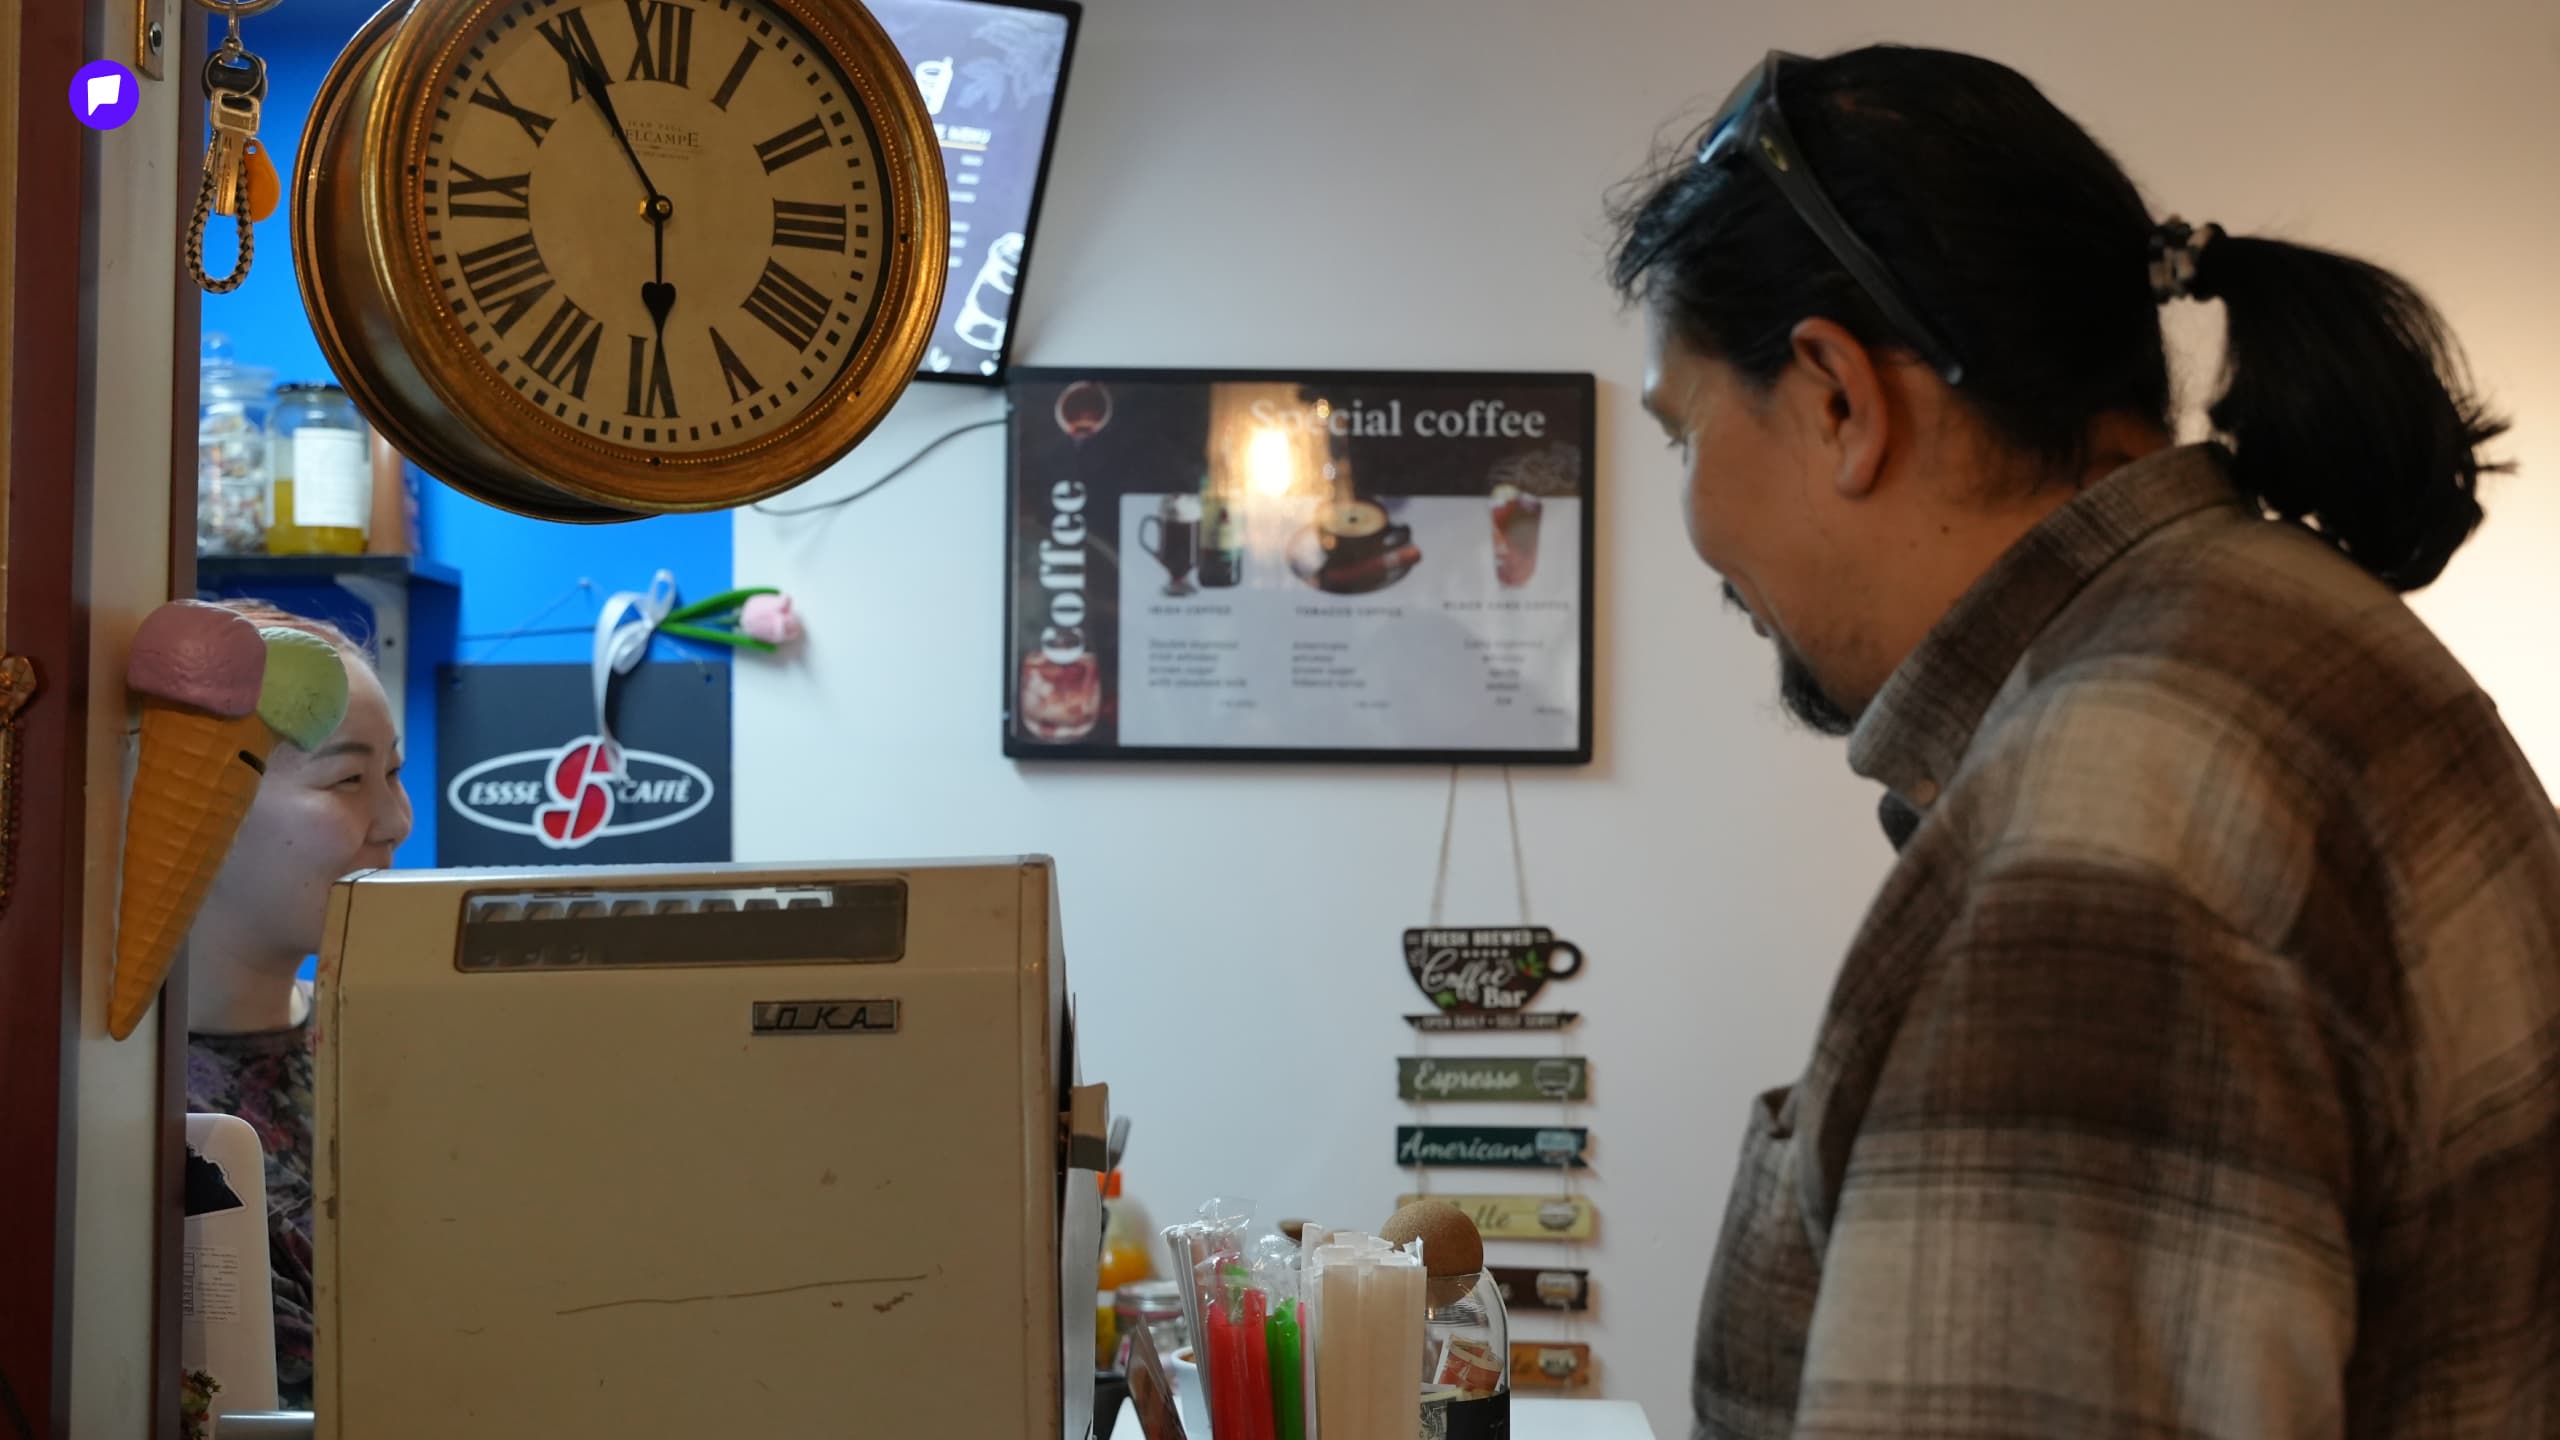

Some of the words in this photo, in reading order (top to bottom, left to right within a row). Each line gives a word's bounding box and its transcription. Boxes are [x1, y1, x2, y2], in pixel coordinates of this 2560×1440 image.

[625, 0, 695, 89] XII
[710, 36, 764, 112] I
[469, 72, 557, 148] X
[753, 114, 832, 176] II
[772, 198, 846, 254] III
[708, 325, 764, 405] V
[1251, 399, 1403, 440] Special
[1414, 398, 1547, 438] coffee
[1039, 480, 1087, 665] Coffee
[468, 781, 543, 806] ESSSE
[1422, 930, 1469, 948] FRESH
[1472, 930, 1533, 947] BREWED
[1421, 948, 1513, 1003] Coffee
[1483, 986, 1527, 1009] Bar
[1413, 1059, 1522, 1097] Espresso
[1399, 1128, 1536, 1162] Americano
